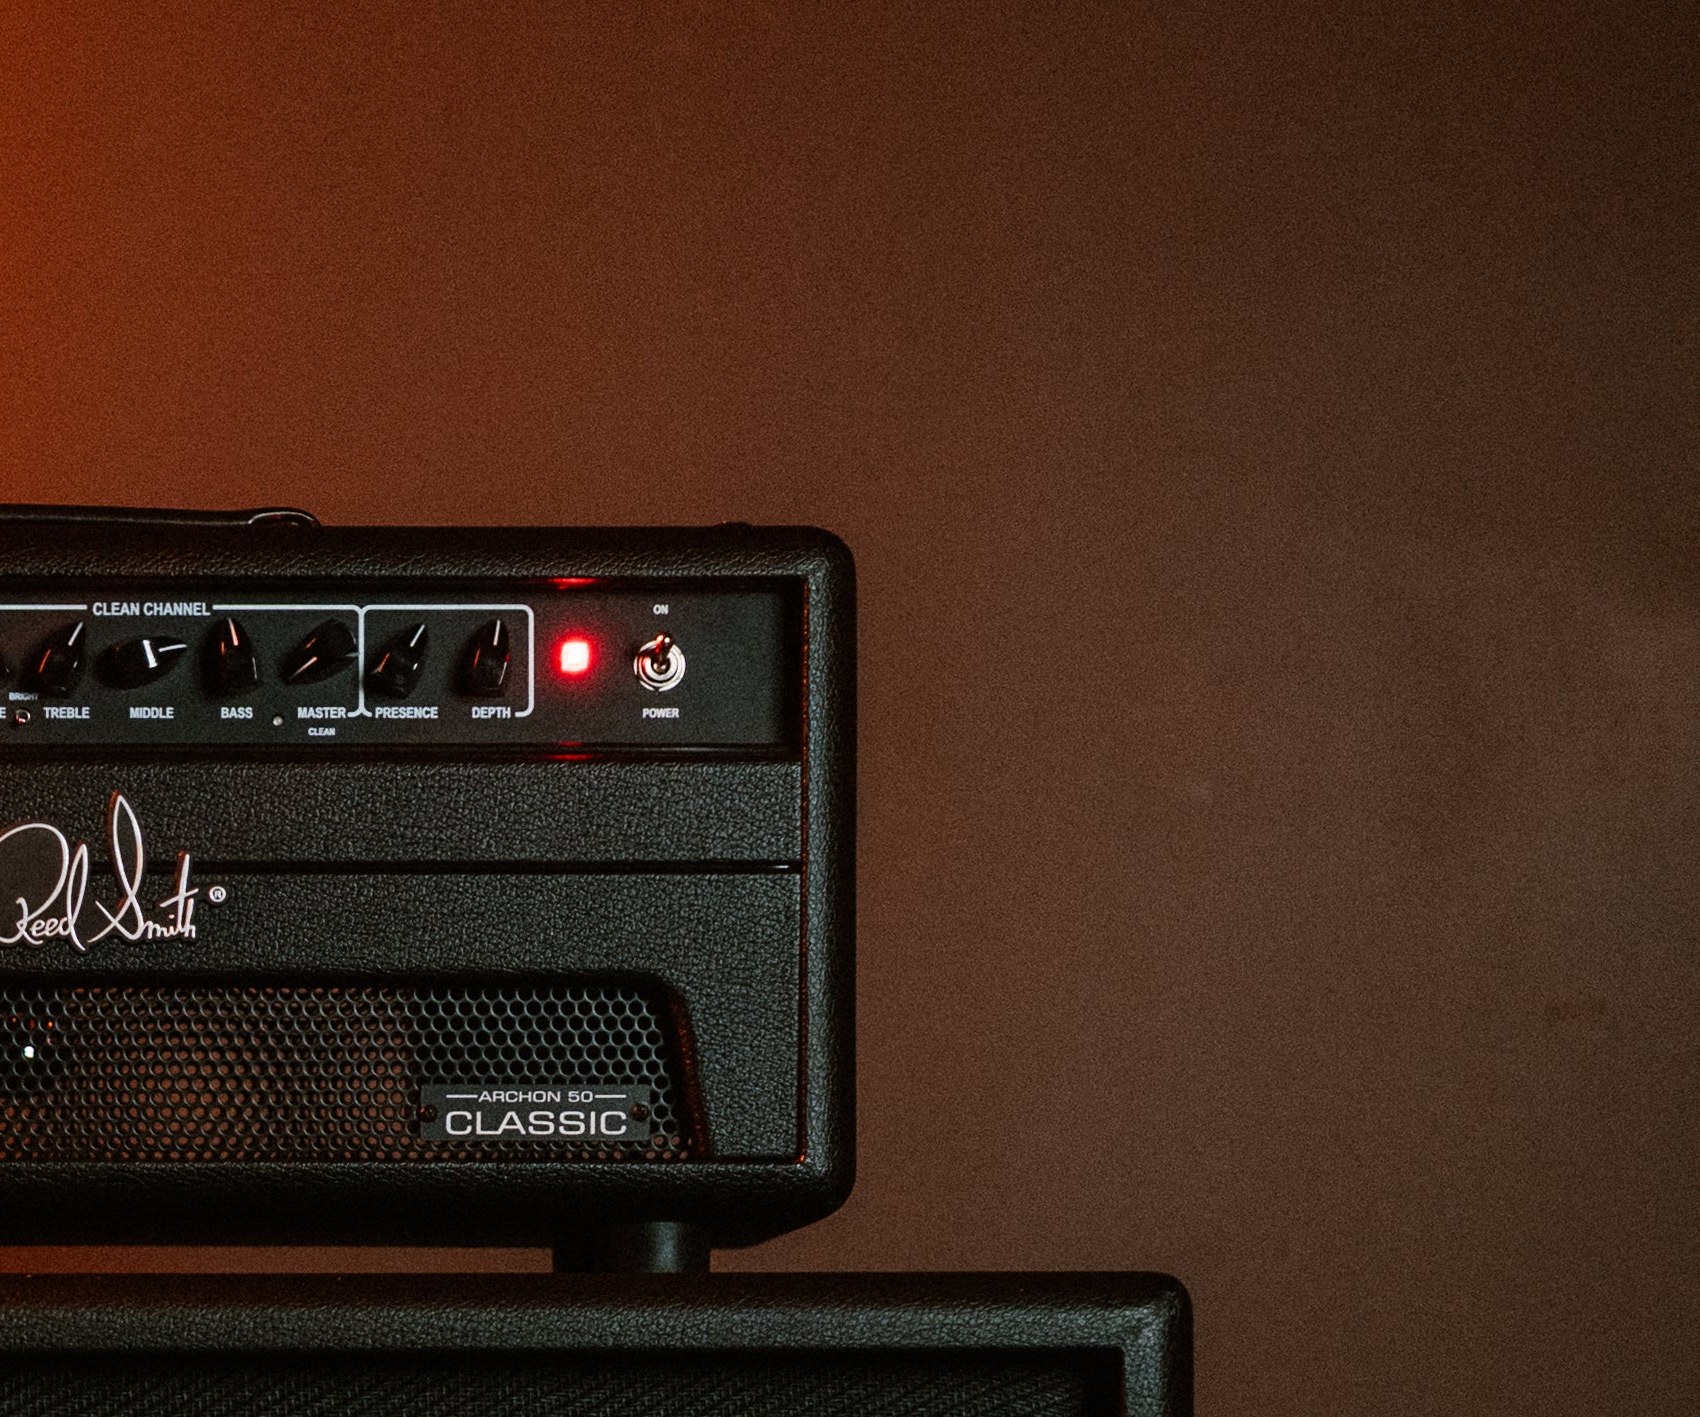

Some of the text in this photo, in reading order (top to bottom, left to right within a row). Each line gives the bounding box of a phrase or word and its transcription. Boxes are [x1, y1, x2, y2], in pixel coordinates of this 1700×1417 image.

[92, 602, 211, 616] CLEAN CHANNEL
[653, 604, 669, 615] ON
[43, 706, 90, 719] TREBLE
[129, 706, 174, 719] MIDDLE
[220, 706, 253, 719] BASS
[297, 706, 347, 719] MASTER
[375, 706, 439, 719] PRESENCE
[471, 706, 511, 719] DEPTH
[642, 708, 680, 719] POWER
[307, 727, 336, 736] CLEAN
[87, 794, 199, 944] Smith
[478, 1090, 594, 1103] ARCHON 50
[445, 1110, 627, 1136] CLASSIC
